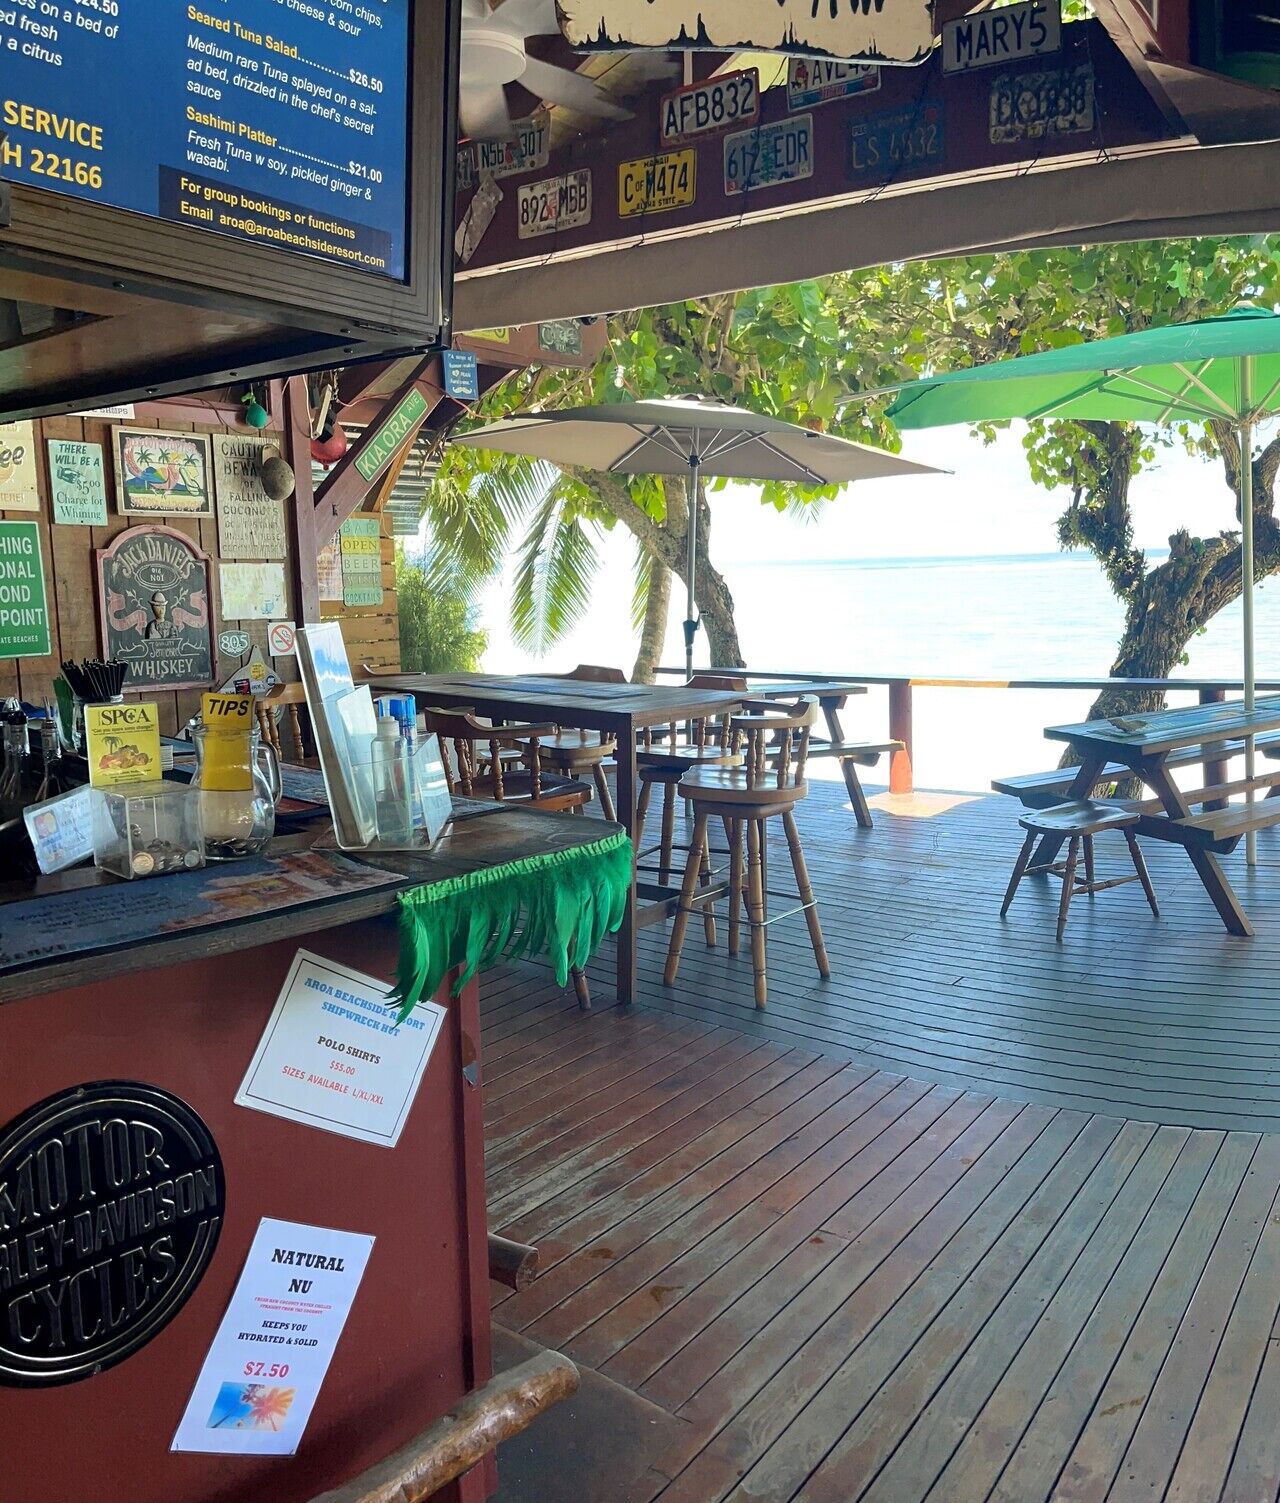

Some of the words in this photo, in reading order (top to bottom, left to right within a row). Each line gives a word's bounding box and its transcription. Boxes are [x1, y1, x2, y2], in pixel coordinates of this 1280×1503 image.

[20, 15, 58, 41] fresh
[41, 3, 59, 18] on
[63, 11, 72, 23] a
[75, 12, 102, 33] bed
[105, 26, 120, 39] of
[187, 4, 231, 34] Seared
[233, 22, 263, 46] Tuna
[338, 20, 361, 37] sour
[355, 6, 384, 29] chips,
[7, 38, 17, 51] a
[22, 43, 63, 66] citrus
[187, 34, 233, 63] Medium
[235, 55, 259, 72] rare
[262, 61, 289, 84] Tuna
[291, 75, 333, 101] splayed
[334, 91, 348, 106] on
[349, 98, 357, 110] a
[358, 101, 378, 117] sal-
[186, 80, 222, 101] sauce
[186, 57, 203, 73] ad
[204, 62, 230, 85] bed,
[232, 73, 277, 100] drizzled
[278, 88, 289, 104] in
[291, 94, 309, 112] the
[310, 101, 342, 124] chef's
[343, 113, 375, 136] secret
[664, 77, 756, 137] AFB832
[3, 100, 104, 151] SERVICE
[186, 105, 236, 136] Sashimi
[238, 122, 278, 148] Platter
[348, 160, 383, 184] $21.00
[727, 142, 761, 180] 612
[773, 129, 810, 169] EDR
[30, 149, 103, 189] 22166
[186, 149, 230, 173] wasabi.
[187, 129, 221, 152] Fresh
[225, 141, 252, 162] Tuna
[255, 154, 265, 166] w
[267, 158, 288, 176] soy,
[291, 165, 328, 187] pickled
[330, 178, 363, 200] ginger
[365, 188, 373, 201] &
[624, 173, 634, 203] C
[635, 181, 645, 193] OF
[180, 177, 202, 195] For
[204, 186, 239, 208] group
[240, 195, 292, 222] bookings
[294, 213, 307, 225] or
[308, 215, 356, 240] functions
[521, 193, 549, 226] 892
[180, 200, 214, 222] Email
[219, 213, 385, 268] aroa@aroabeachsideresort.com
[59, 444, 87, 454] THERE
[360, 446, 387, 476] KIA
[383, 413, 413, 448] ORA
[55, 455, 77, 465] WILL
[80, 456, 91, 466] BE
[94, 457, 101, 467] A
[56, 492, 88, 507] Charge
[91, 494, 103, 505] for
[60, 505, 102, 520] Whining
[343, 522, 376, 534] BAR
[342, 540, 377, 550] OPEN
[117, 542, 147, 578] JACK
[344, 559, 379, 570] BEER
[0, 608, 44, 627] POINT
[13, 633, 39, 644] BEACHES
[221, 635, 249, 649] 805
[131, 658, 194, 677] WHISKEY
[101, 708, 151, 726] SPCA
[208, 698, 250, 716] TIPS
[304, 977, 335, 998] AROA
[334, 989, 389, 1018] BEACHSIDE
[321, 1001, 381, 1031] SHIPWRECK
[380, 1024, 401, 1037] HUT
[317, 1035, 346, 1052] POLO
[347, 1046, 381, 1065] SHIRTS
[329, 1060, 356, 1076] $55.00
[282, 1065, 307, 1080] SIZES
[307, 1074, 349, 1095] AVAILABLE
[352, 1088, 384, 1105] L/XL/XXL
[0, 1118, 170, 1232] MOTOR
[271, 1248, 345, 1272] NATURAL
[8, 1234, 176, 1348] CYCLES
[288, 1278, 313, 1294] NU
[262, 1320, 290, 1331] KEEPS
[291, 1323, 308, 1332] YOU
[238, 1332, 285, 1344] HYDRATED
[286, 1337, 293, 1345] &
[293, 1338, 318, 1347] SOLID
[243, 1361, 289, 1378] $7.50
